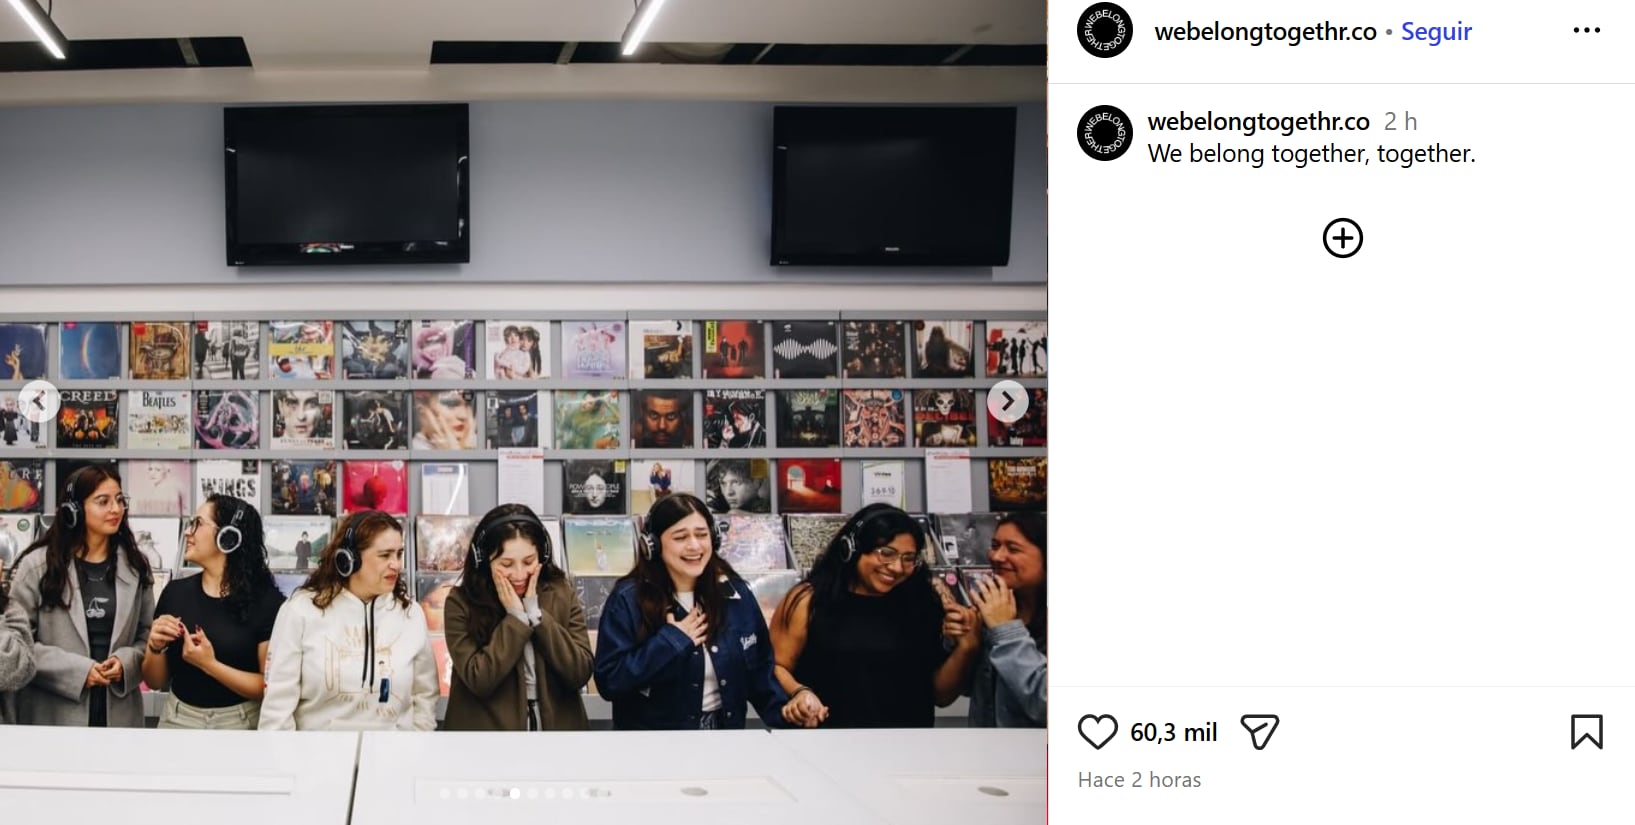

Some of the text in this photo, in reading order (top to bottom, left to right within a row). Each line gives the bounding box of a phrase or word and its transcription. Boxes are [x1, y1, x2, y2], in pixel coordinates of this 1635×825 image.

[60, 390, 118, 403] CREED
[142, 391, 177, 409] BEATLES
[201, 478, 256, 498] WINGS
